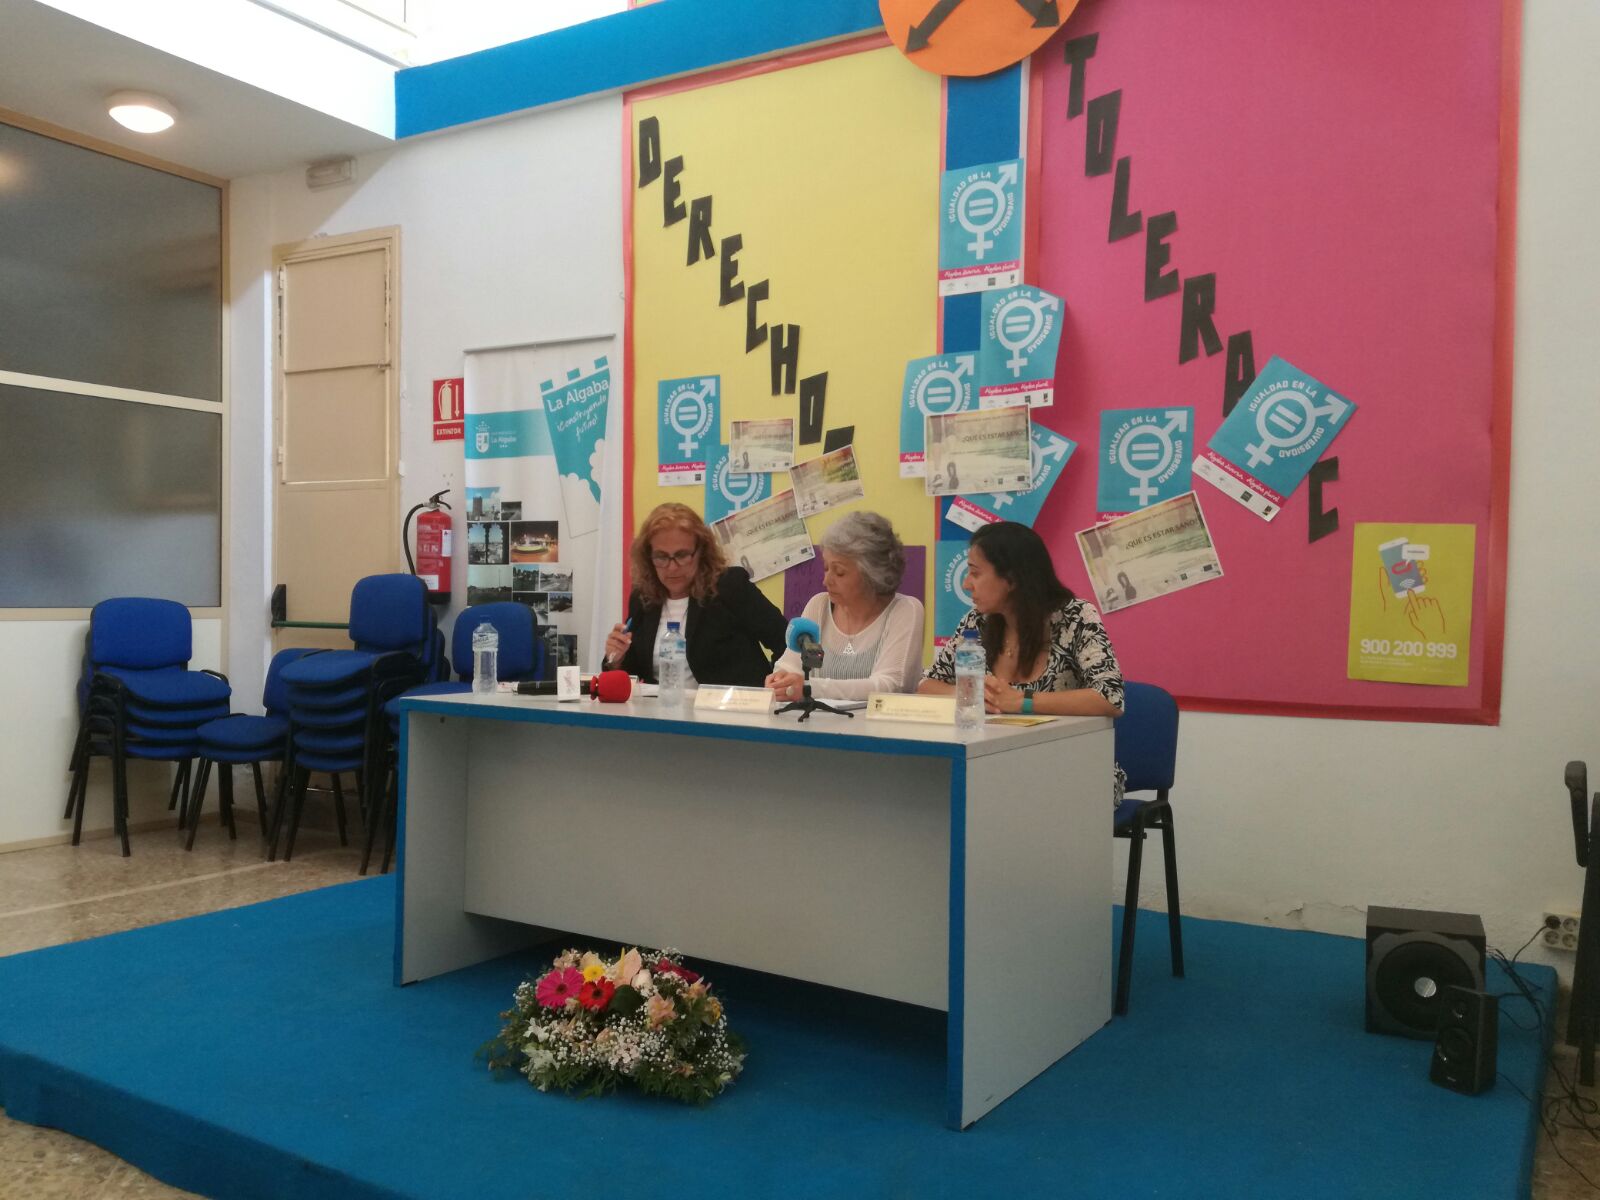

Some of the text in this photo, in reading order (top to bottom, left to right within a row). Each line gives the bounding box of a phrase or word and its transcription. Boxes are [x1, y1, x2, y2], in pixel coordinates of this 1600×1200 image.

[948, 171, 991, 223] IGUALDAD EN LA
[993, 192, 1014, 236] DIVERSIDAD
[988, 289, 1032, 340] IGUALDAD EN LA
[1026, 314, 1053, 354] DIVERSIDAD
[547, 379, 609, 412] La Algaba
[908, 360, 949, 408] IGUALDAD EN LA
[1248, 380, 1318, 412] IGUALDAD EN LA
[663, 390, 678, 425] IGUALDAD
[1109, 415, 1157, 464] IGUALDAD EN LA
[1279, 426, 1325, 458] DIVERSIDAD
[712, 455, 727, 491] IGUALDAD
[1158, 440, 1183, 484] DIVERSIDAD
[1143, 534, 1152, 543] ES
[1153, 526, 1175, 539] ESTAR
[944, 553, 962, 593] IGUALDAD
[1360, 638, 1457, 659] 900 200 999
